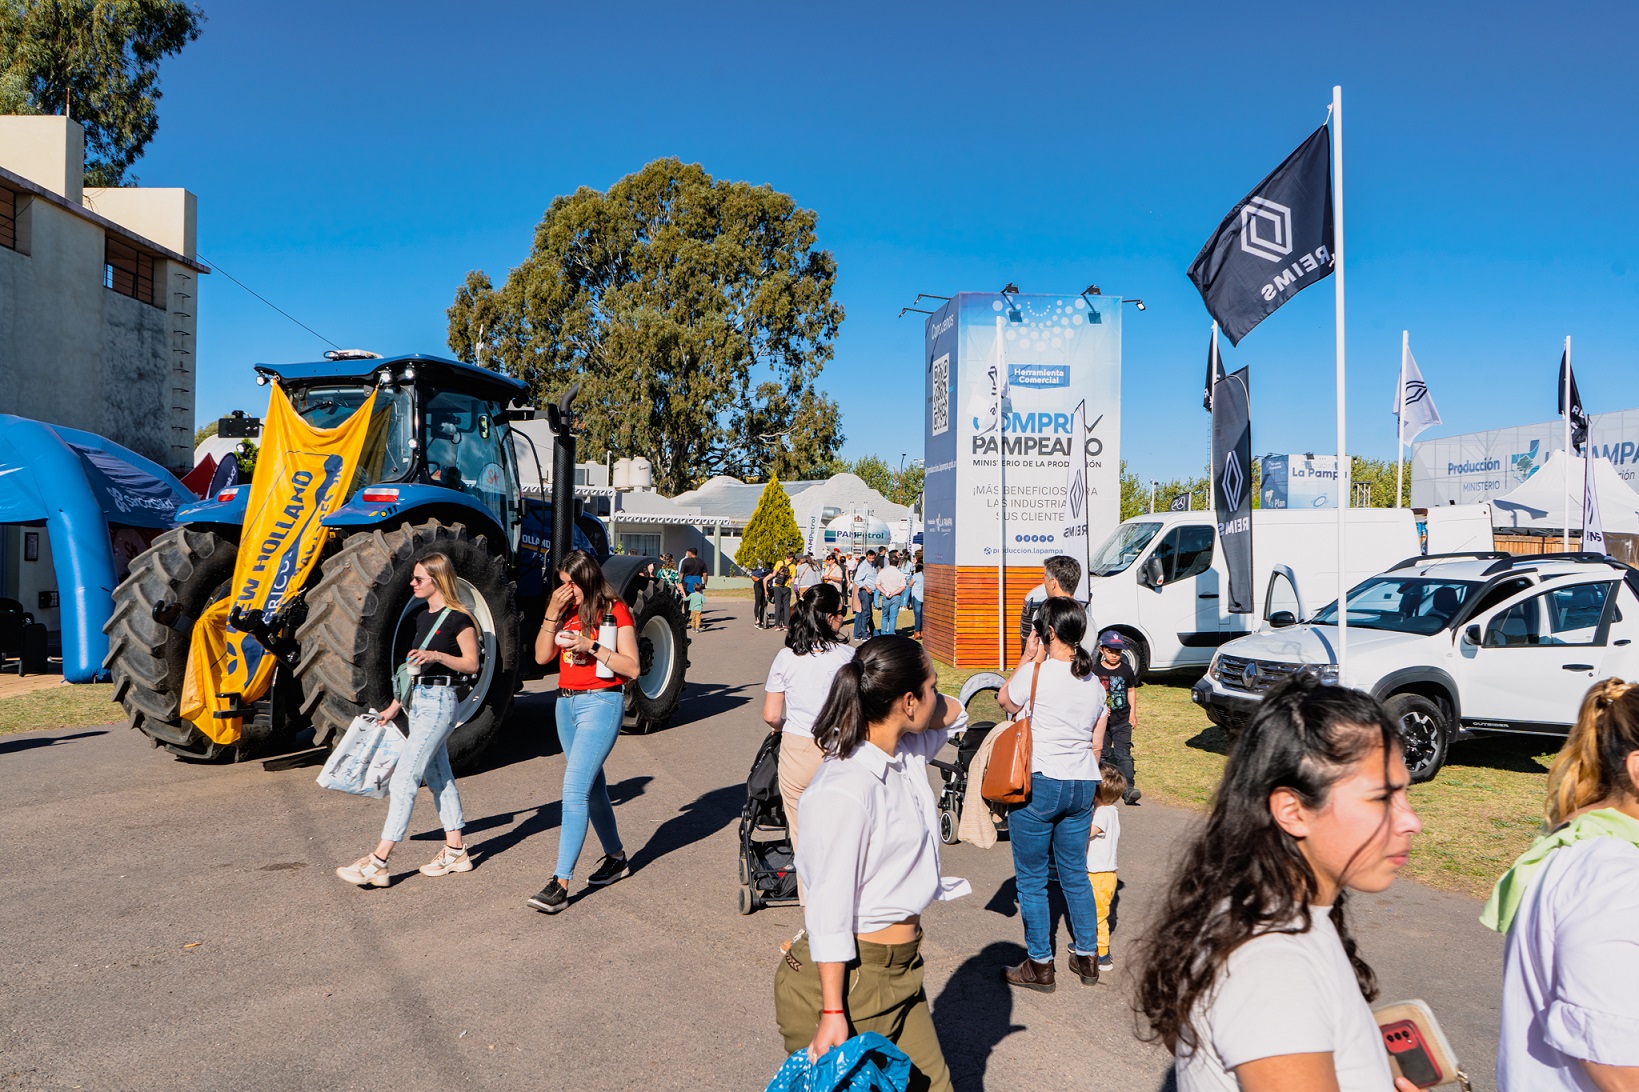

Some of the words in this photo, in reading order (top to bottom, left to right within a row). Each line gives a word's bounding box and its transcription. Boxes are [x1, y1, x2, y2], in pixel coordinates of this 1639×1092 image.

[1014, 368, 1064, 377] Herramienta
[1018, 376, 1060, 384] Comercial
[973, 411, 1075, 434] OMPR
[973, 459, 1021, 467] MINISERIO
[1023, 460, 1033, 468] DE
[1036, 460, 1046, 468] LA
[1048, 460, 1102, 468] PRODIÓN
[1448, 457, 1500, 475] Producción
[1292, 467, 1305, 477] La
[1308, 468, 1348, 480] Pamp
[1003, 486, 1067, 495] BENEFICIOS
[1463, 481, 1500, 491] MINISTERIO
[987, 499, 1007, 508] LAS
[1010, 500, 1067, 508] INDUSTRIA
[253, 471, 313, 571] HOLLAND
[1021, 512, 1065, 521] CLIENTE
[522, 534, 551, 549] OLLAND
